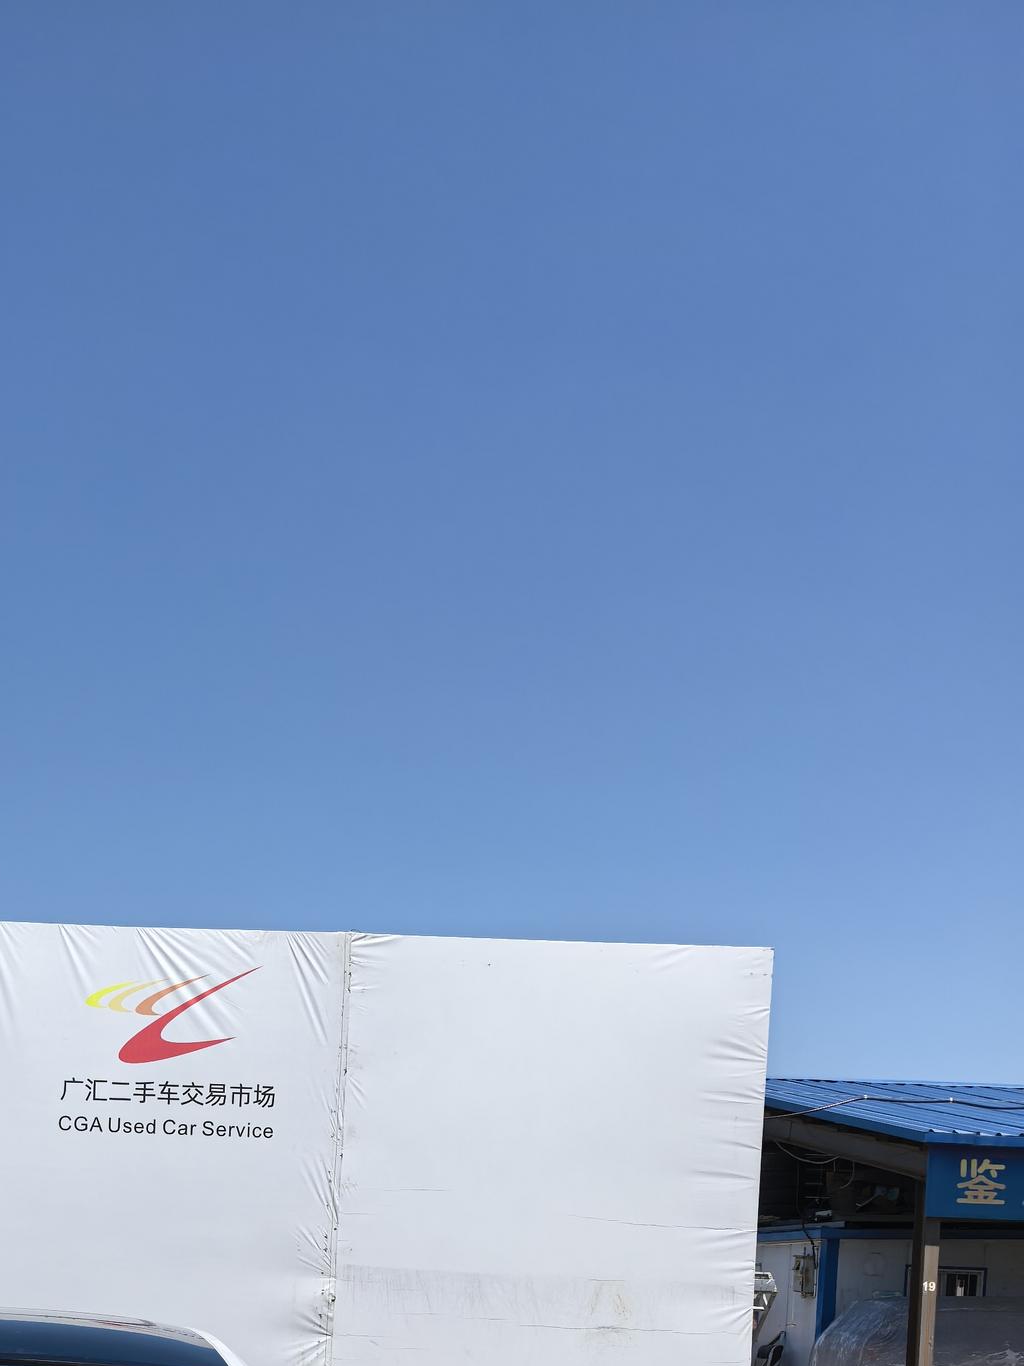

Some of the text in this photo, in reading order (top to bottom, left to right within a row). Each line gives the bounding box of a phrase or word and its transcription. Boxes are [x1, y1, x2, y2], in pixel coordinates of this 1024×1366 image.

[60, 1077, 275, 1108] 广汇二手车交易市场
[58, 1115, 274, 1138] CGA Used Car Service
[956, 1158, 1006, 1205] 鉴
[922, 1280, 936, 1292] 19
